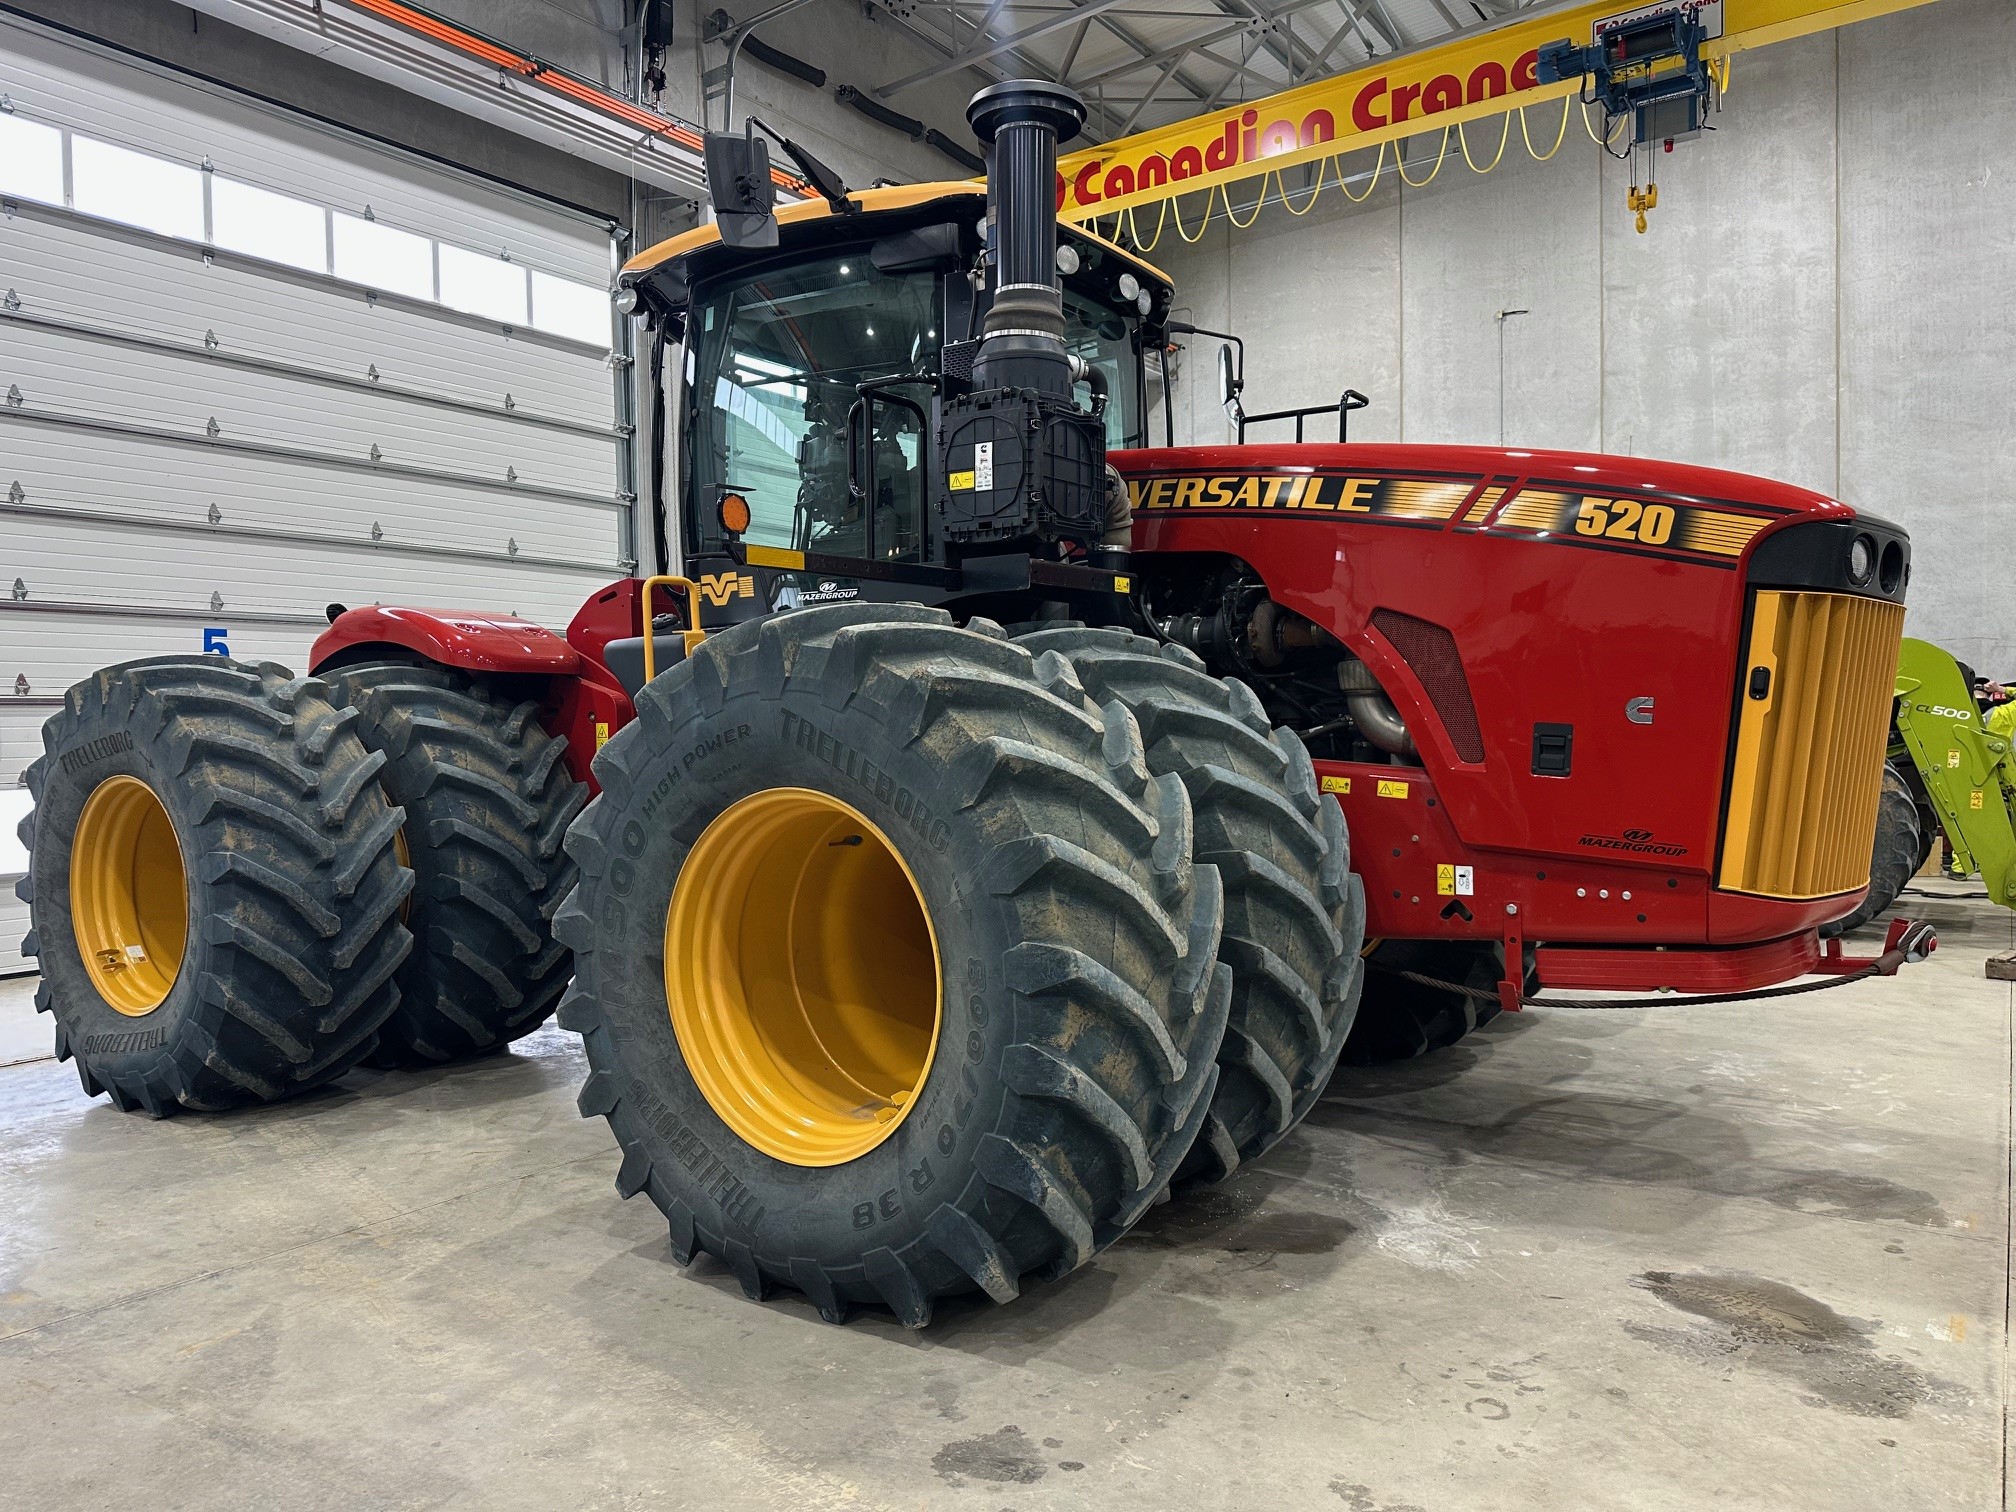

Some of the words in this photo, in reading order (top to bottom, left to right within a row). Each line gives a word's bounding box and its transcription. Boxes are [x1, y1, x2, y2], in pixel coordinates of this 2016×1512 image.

[1074, 109, 1335, 206] Canadian
[1129, 476, 1381, 513] VERSATILE
[1575, 496, 1676, 545] 520
[797, 590, 858, 601] MAZERGROUP
[203, 628, 230, 657] 5
[59, 729, 134, 775] TRELLEBORG
[641, 766, 682, 822] HIGH
[684, 722, 753, 772] POWER
[778, 706, 954, 854] TRELLEBORG
[1577, 836, 1689, 857] MAZERGROUP
[85, 1026, 169, 1055] TRELLEBORG
[626, 1078, 767, 1240] TRELLEBORG
[909, 1157, 936, 1195] R
[852, 1187, 902, 1232] 38
